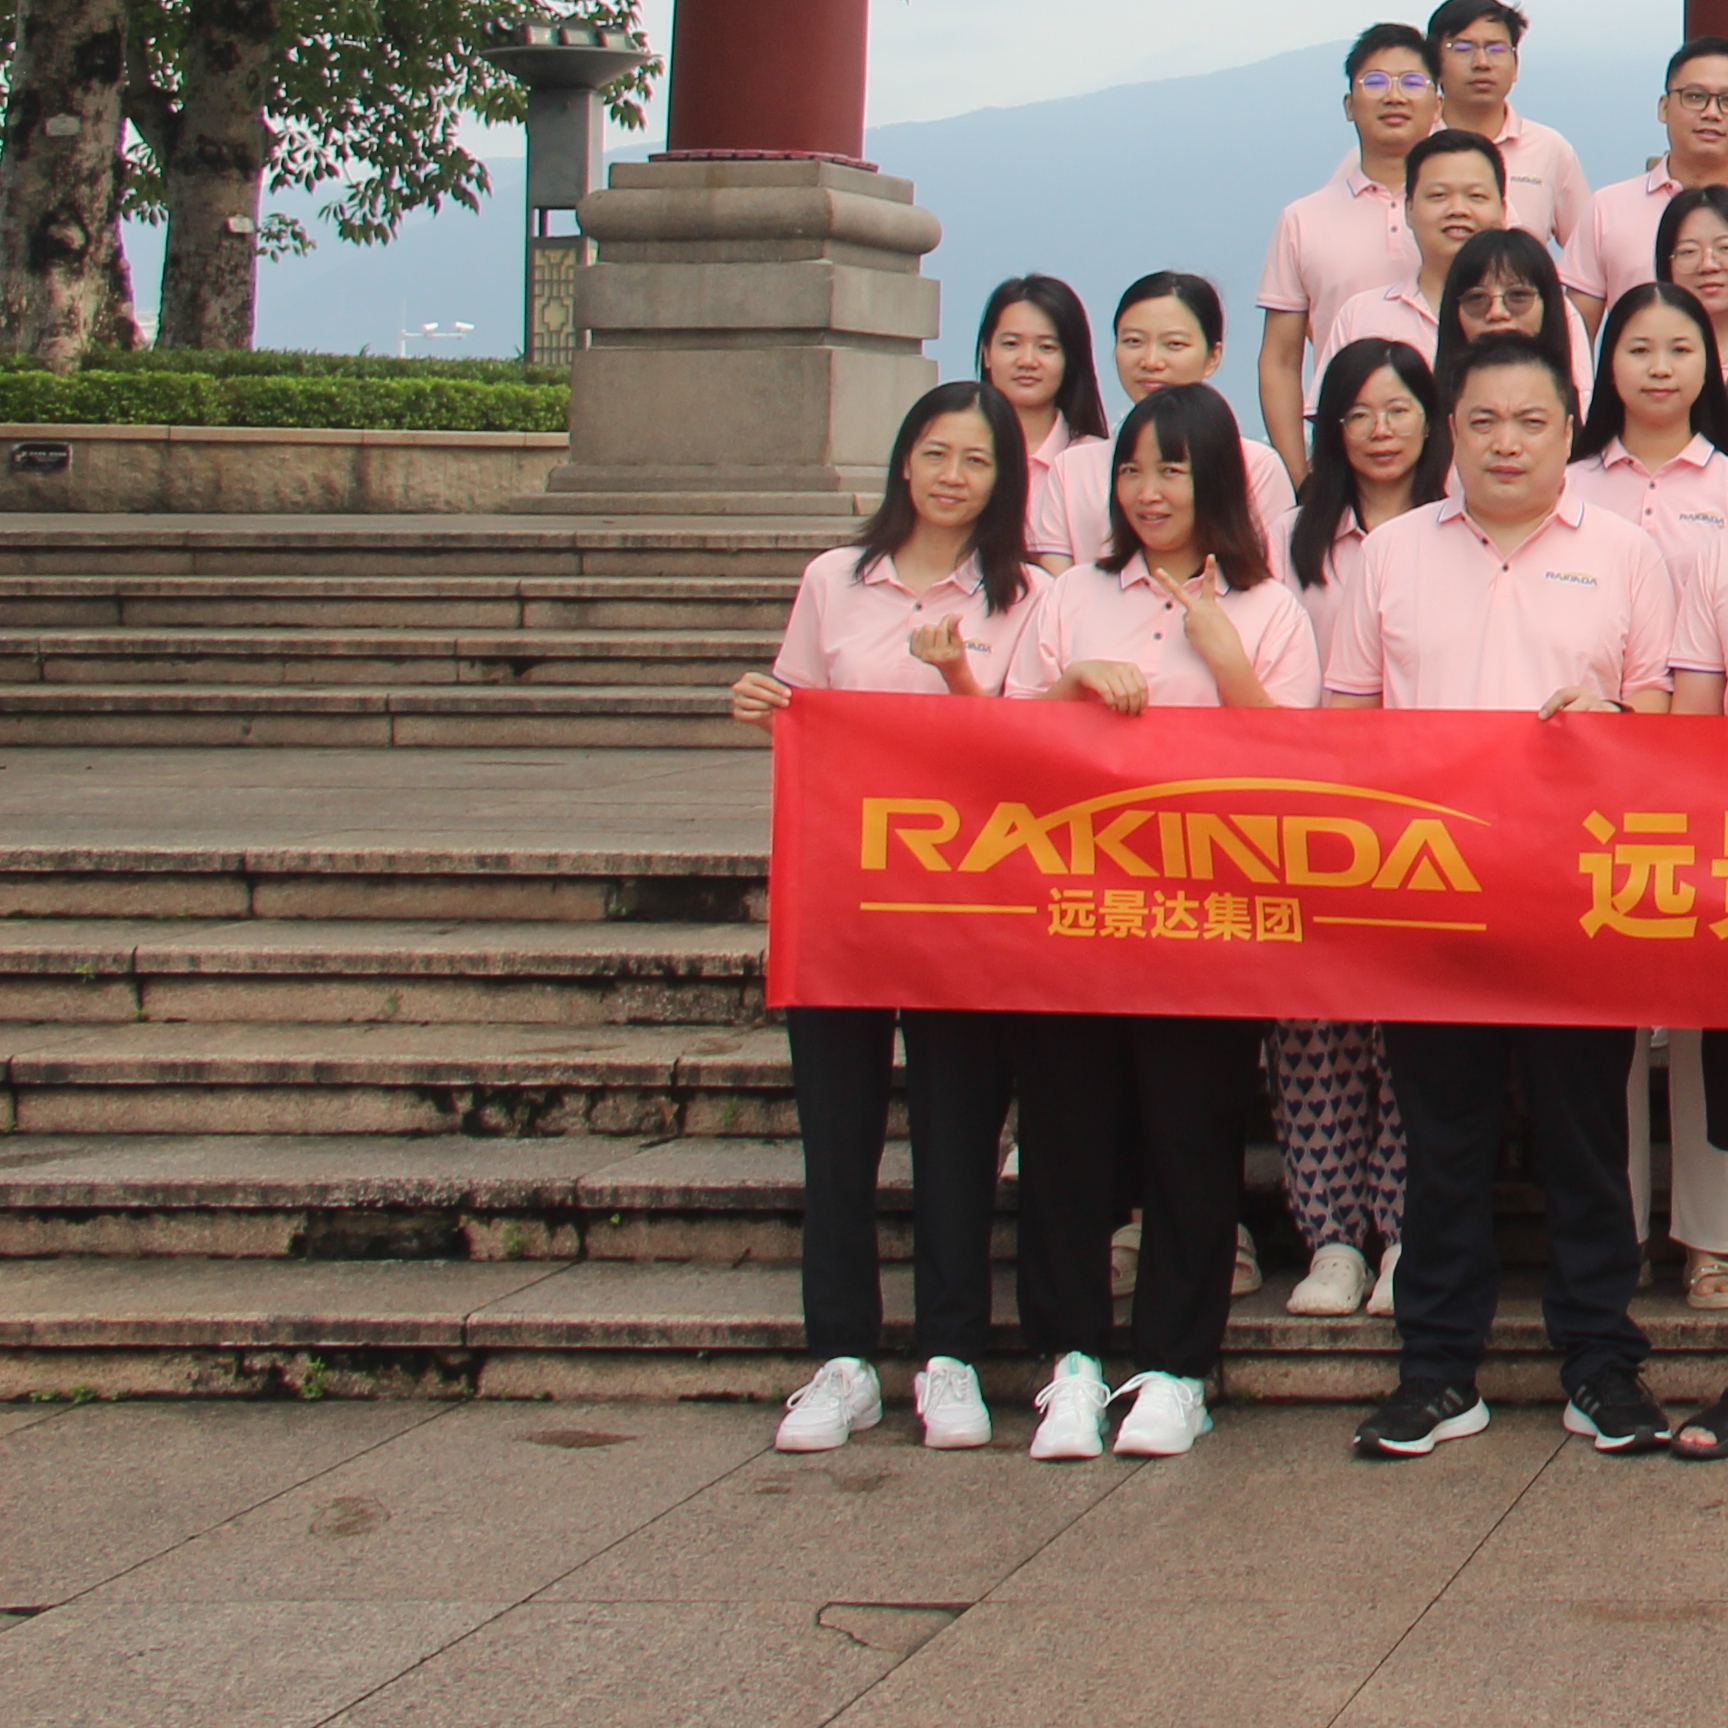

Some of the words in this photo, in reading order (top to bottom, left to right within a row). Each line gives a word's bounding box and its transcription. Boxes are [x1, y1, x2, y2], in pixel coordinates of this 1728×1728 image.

[861, 795, 1482, 893] RAKINDA
[1047, 887, 1305, 943] 远景达集团
